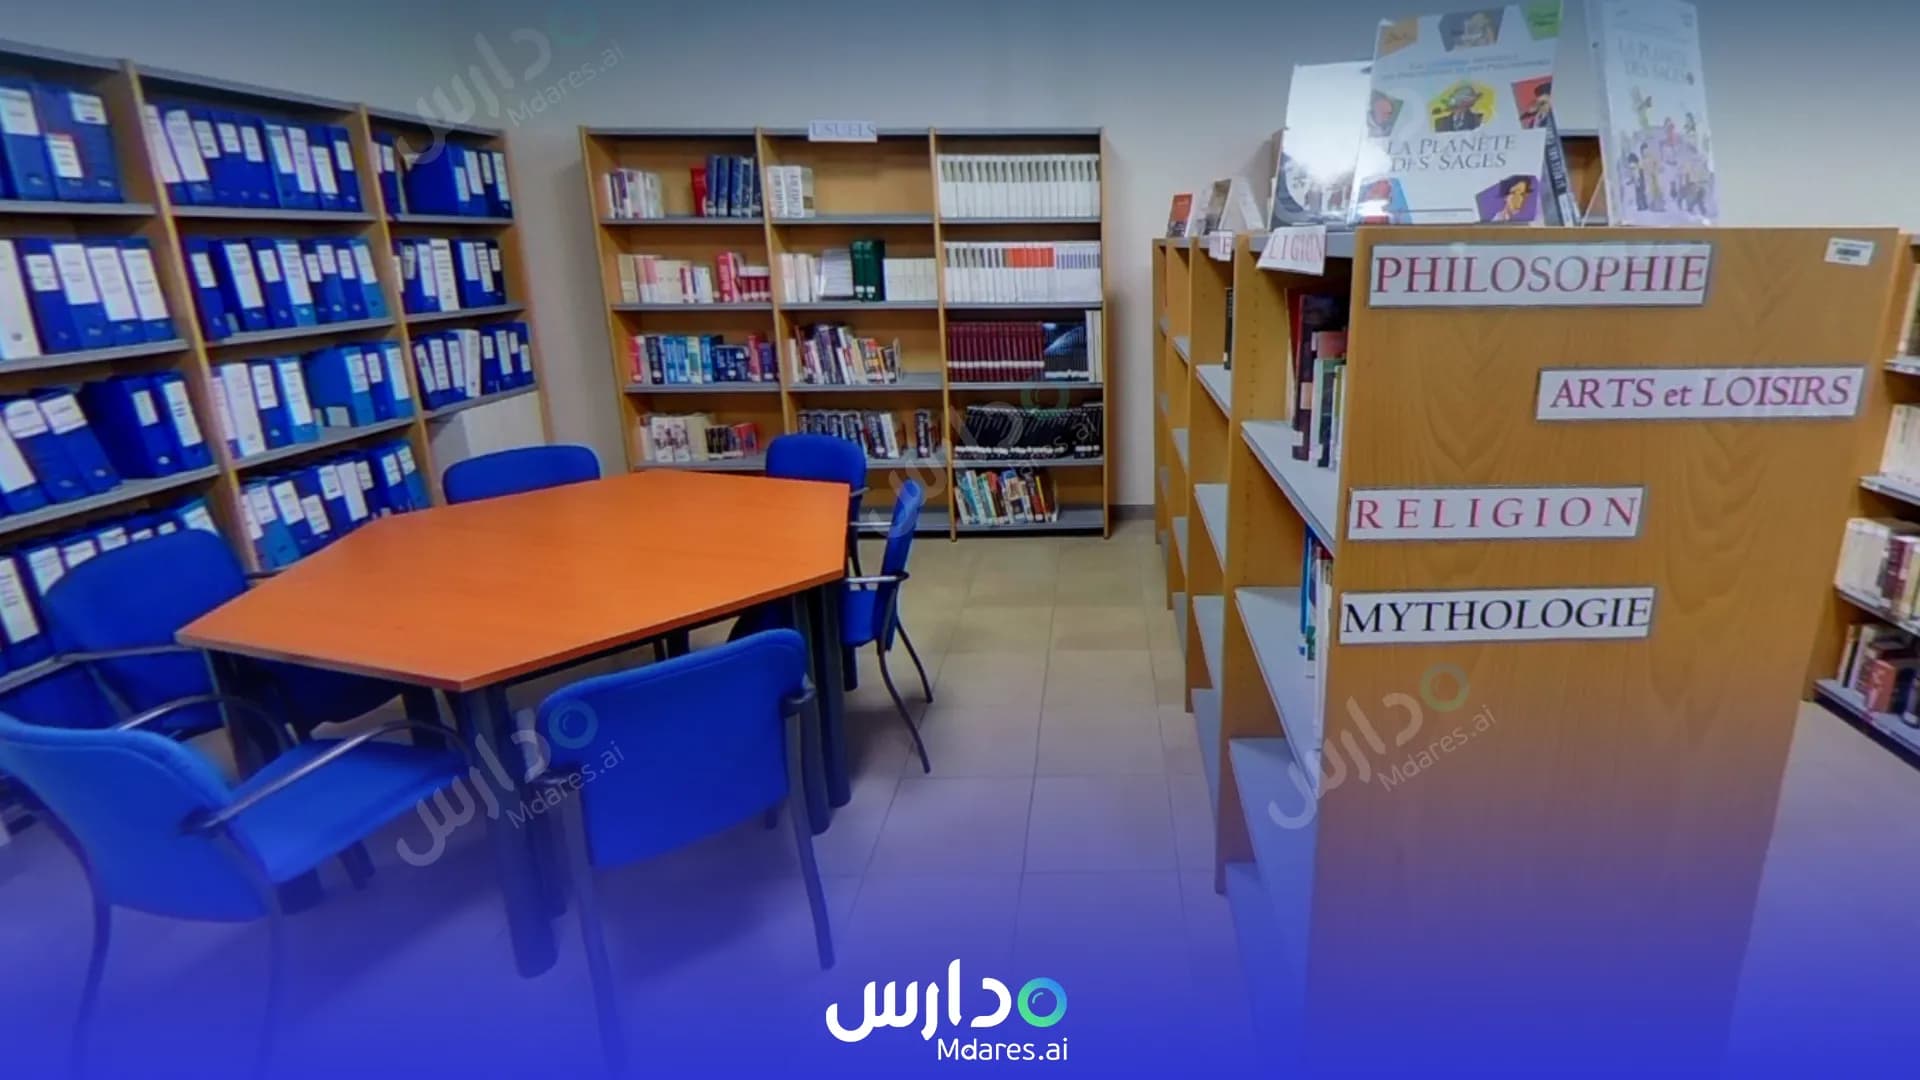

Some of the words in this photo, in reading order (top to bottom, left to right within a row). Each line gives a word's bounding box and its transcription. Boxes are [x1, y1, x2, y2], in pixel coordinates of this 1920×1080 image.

[1439, 151, 1507, 170] SAGES
[1373, 255, 1706, 293] PHILOSOPHIE
[1550, 377, 1655, 408] ARTS
[1663, 384, 1693, 407] et
[1701, 375, 1852, 407] LOISIRS
[1354, 497, 1638, 530] RELIGION
[1343, 597, 1651, 633] MYTHOLOGIE
